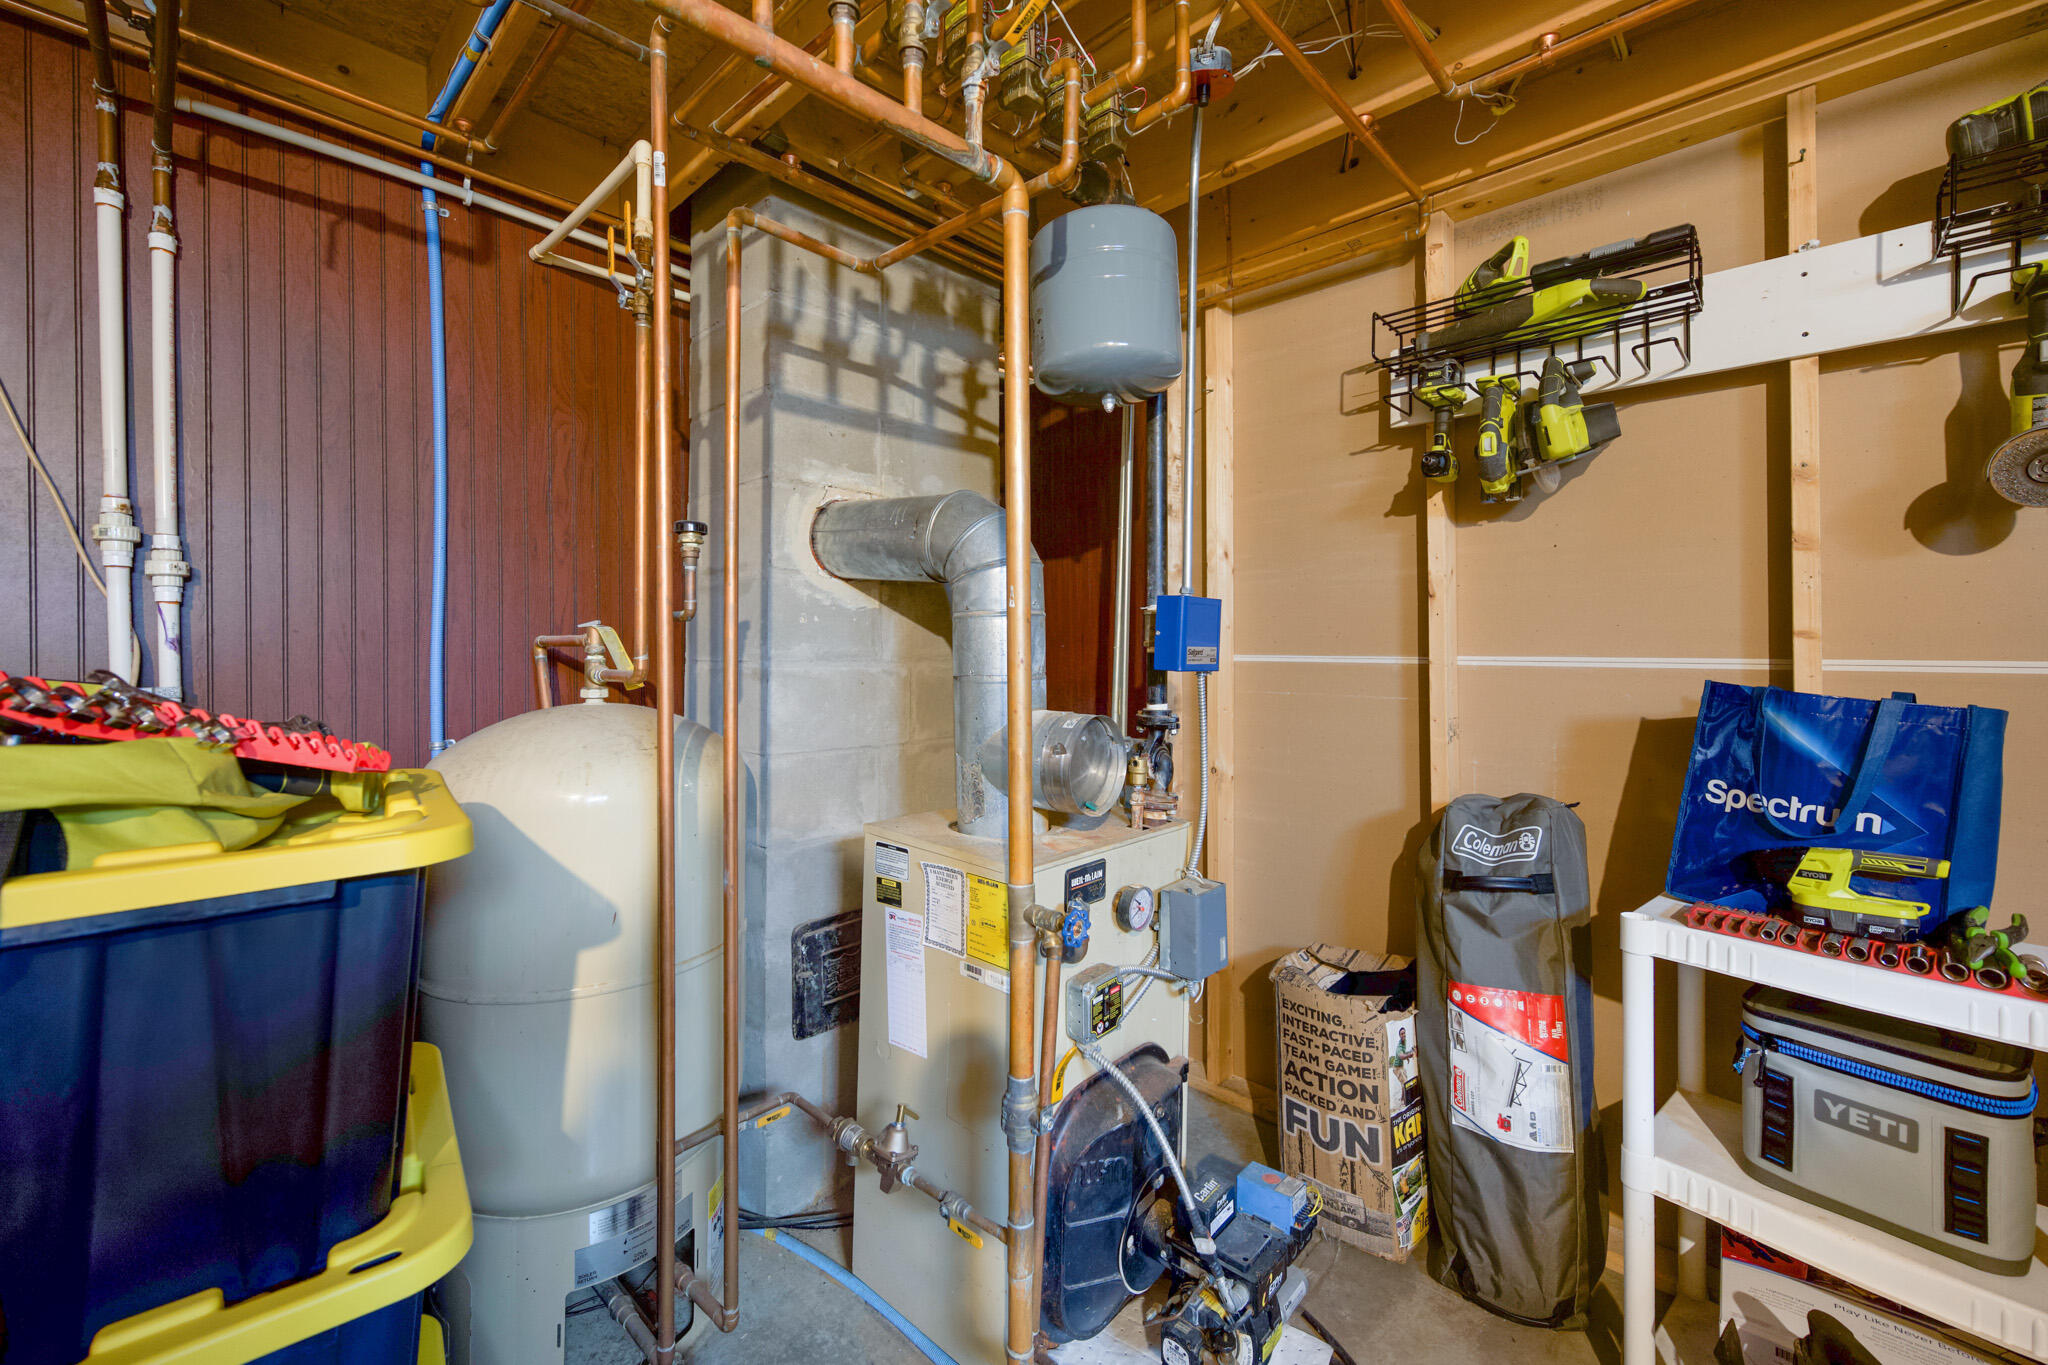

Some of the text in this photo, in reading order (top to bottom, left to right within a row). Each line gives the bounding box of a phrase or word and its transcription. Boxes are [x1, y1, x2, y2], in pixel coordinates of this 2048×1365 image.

[1463, 831, 1518, 857] Coleman
[1801, 870, 1827, 880] RYOBI
[1282, 998, 1346, 1029] EXCITING,
[1282, 1013, 1379, 1051] INTERACTIVE,
[1283, 1028, 1374, 1063] FAST-PACED
[1284, 1043, 1377, 1080] TEAM GAME!
[1284, 1060, 1379, 1105] ACTION
[1285, 1081, 1376, 1121] PACKED AND
[1285, 1096, 1381, 1164] FUN
[1402, 1105, 1423, 1120] ORIGIN
[1822, 1098, 1908, 1145] YETI
[1193, 1179, 1218, 1202] Carlin
[1833, 1303, 1863, 1318] Play
[1864, 1314, 1890, 1328] Like
[1894, 1325, 1934, 1346] Never
[1937, 1342, 1987, 1364] Before
